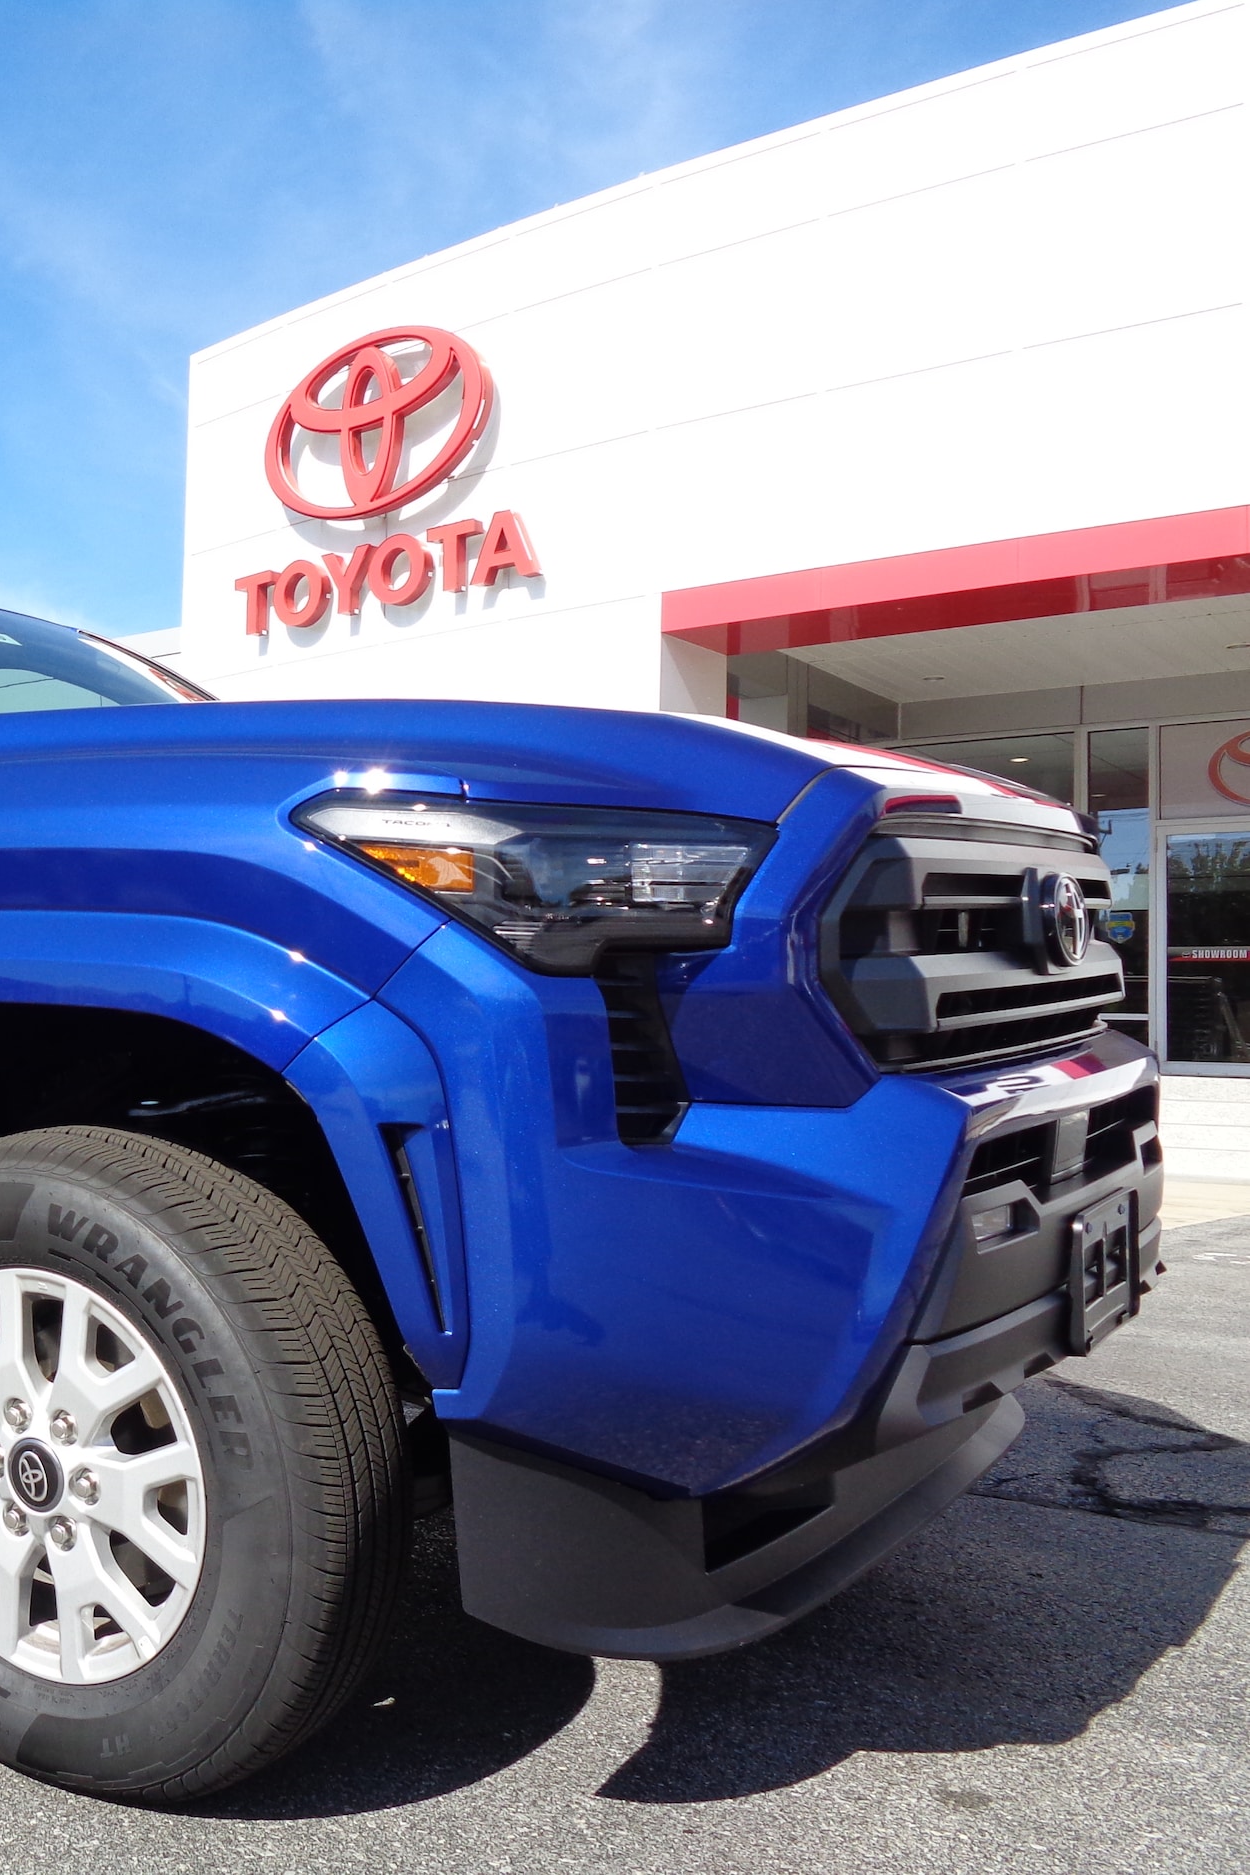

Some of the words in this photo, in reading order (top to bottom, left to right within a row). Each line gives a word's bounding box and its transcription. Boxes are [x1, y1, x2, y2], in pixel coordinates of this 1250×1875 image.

[235, 510, 542, 636] TOYOTA
[381, 818, 451, 828] TACO
[1191, 949, 1248, 959] SHOWROOM
[47, 1202, 254, 1471] WRANGLER
